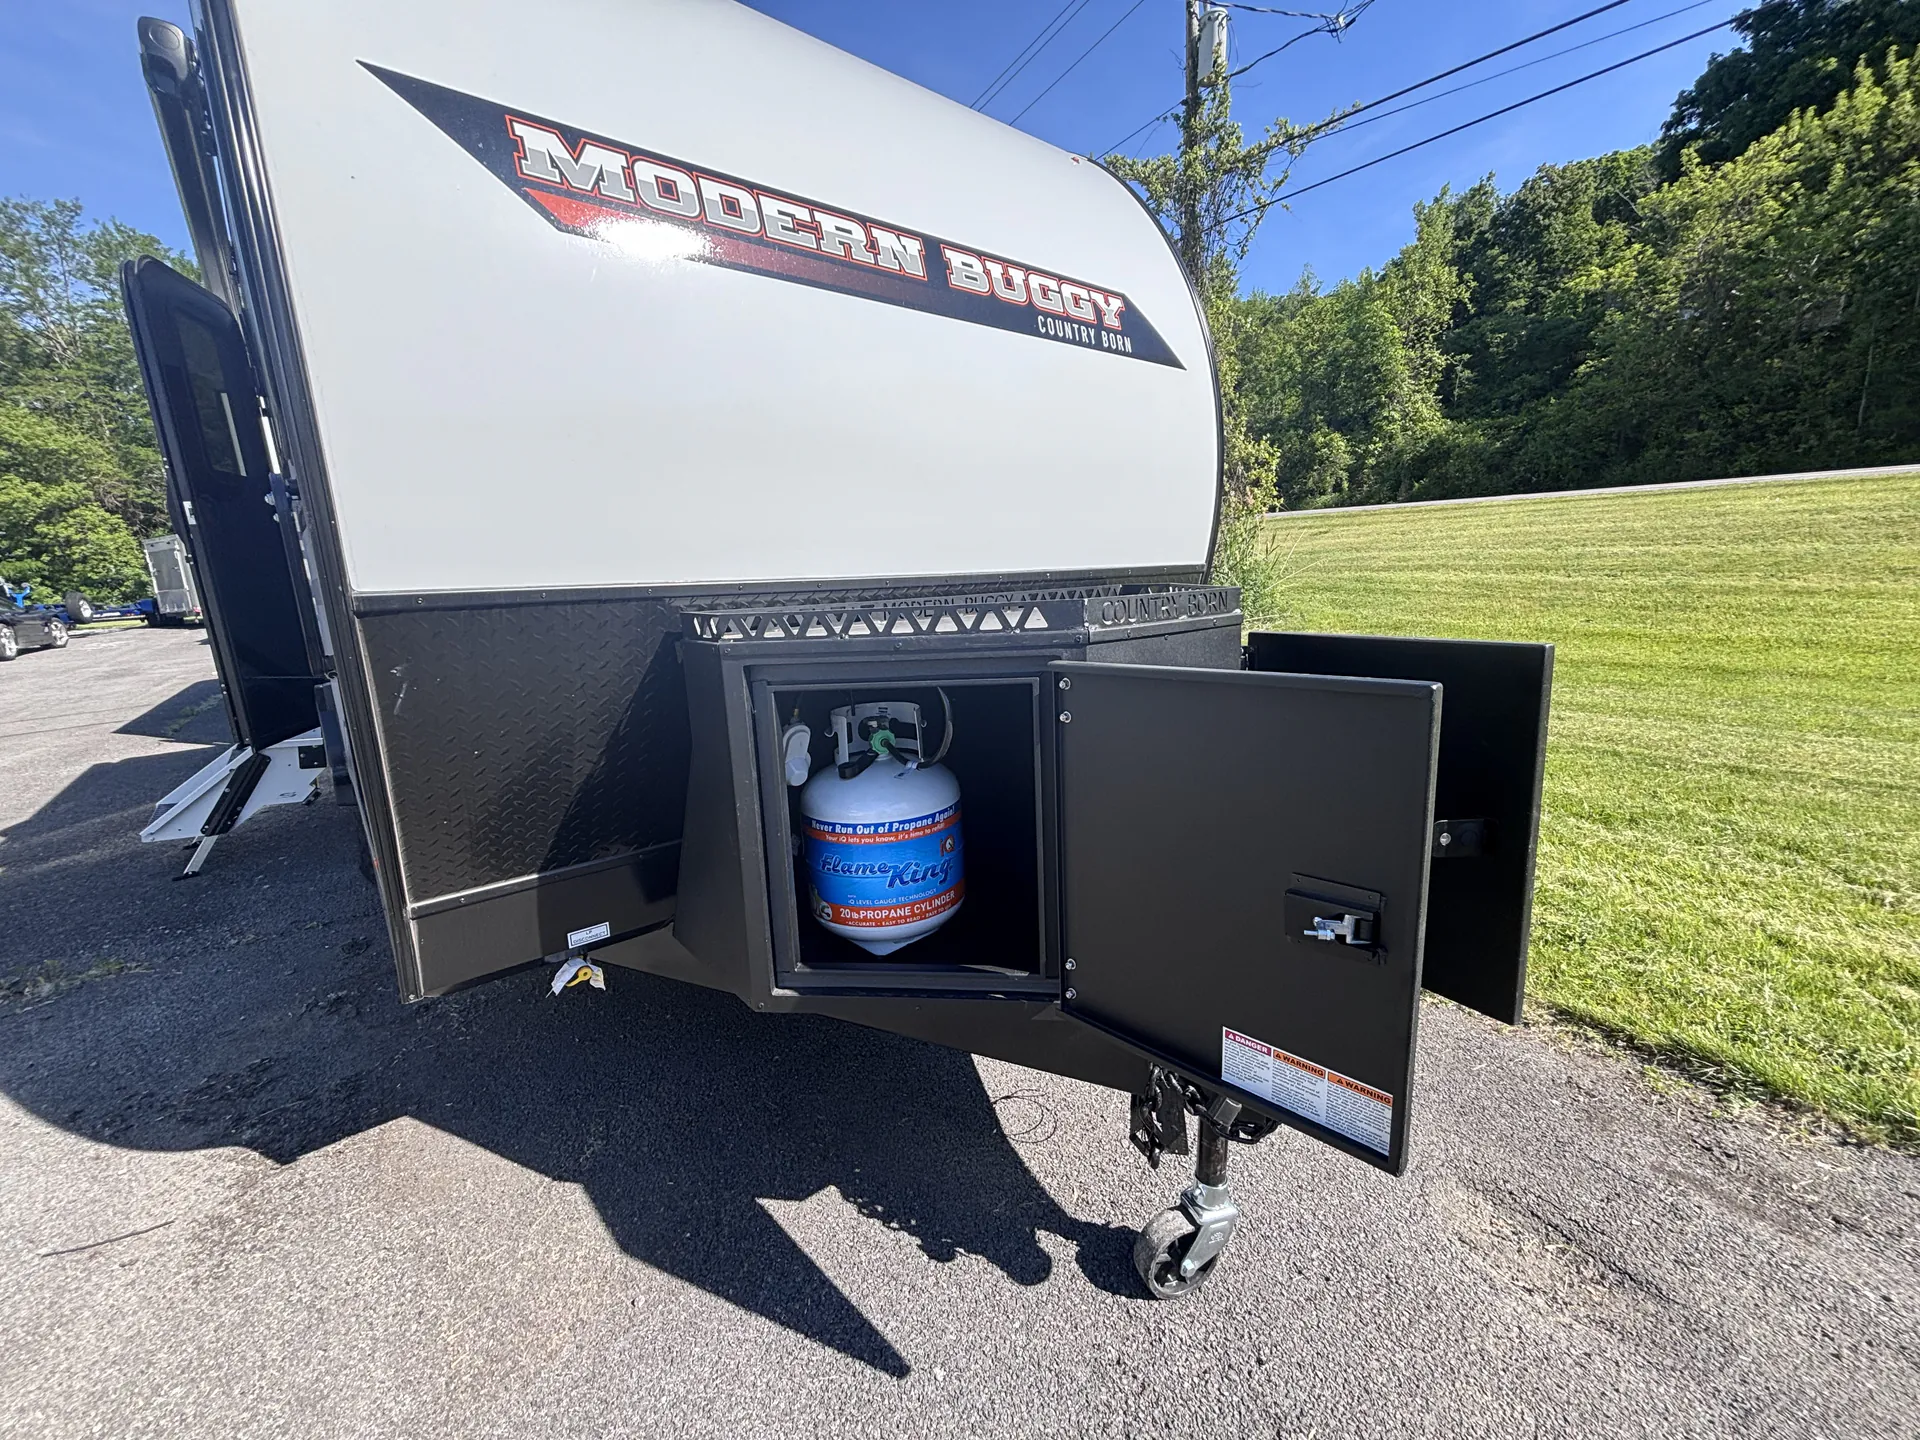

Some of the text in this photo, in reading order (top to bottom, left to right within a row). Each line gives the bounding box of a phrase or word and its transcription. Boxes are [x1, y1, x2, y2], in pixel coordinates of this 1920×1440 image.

[506, 116, 1125, 330] MODERN BUGGY
[1038, 315, 1132, 353] COUNTRY BORN
[1102, 591, 1228, 625] COUNTRY BORN
[811, 805, 955, 834] Never Run Out of Propane Again!
[898, 832, 908, 840] it's
[910, 830, 923, 838] time
[820, 853, 955, 889] Flame King
[840, 908, 851, 918] 20
[860, 906, 911, 919] PROPANE
[914, 890, 955, 913] CYLINDER
[898, 888, 937, 902] TECHNOLOGY
[1235, 1035, 1268, 1054] DANGER
[1282, 1055, 1324, 1077] WARNING
[1345, 1081, 1391, 1105] WARNING
